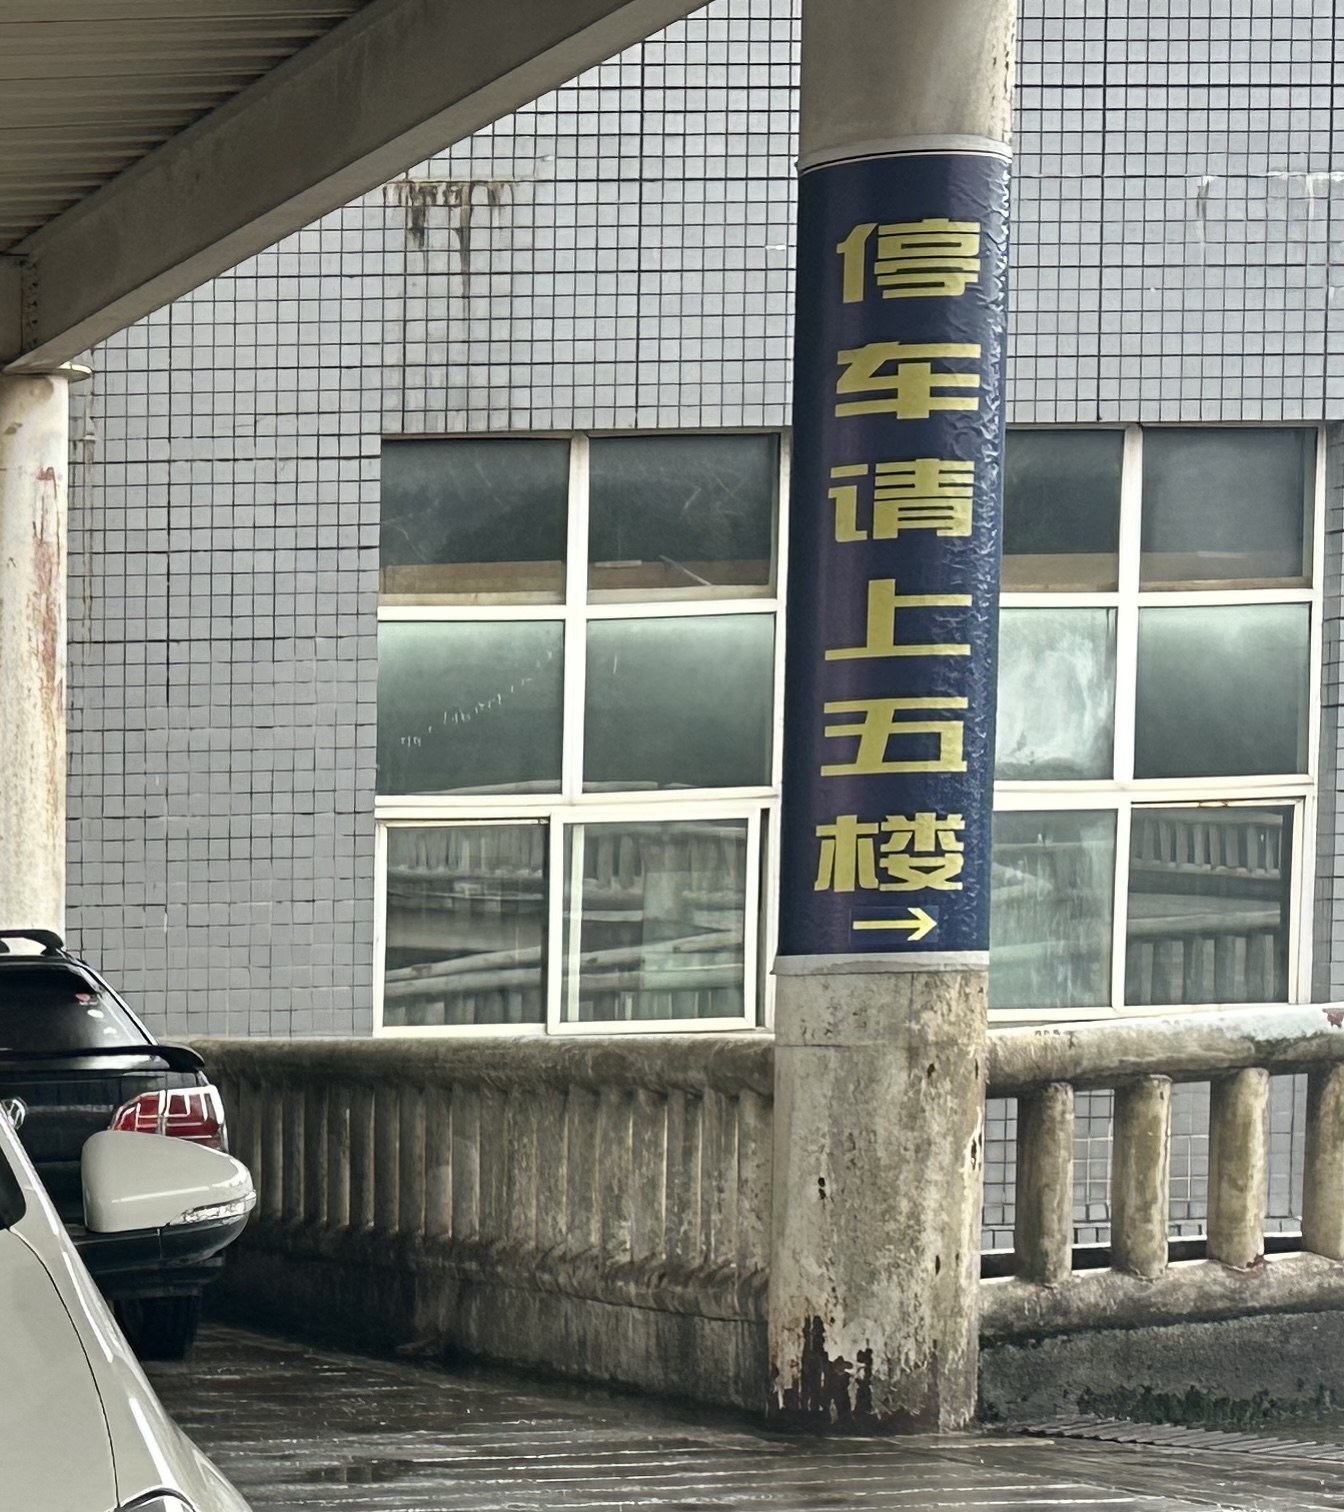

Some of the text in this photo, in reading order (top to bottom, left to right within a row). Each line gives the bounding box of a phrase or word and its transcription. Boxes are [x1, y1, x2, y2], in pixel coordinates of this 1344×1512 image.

[814, 218, 982, 893] 停车请上五楼
